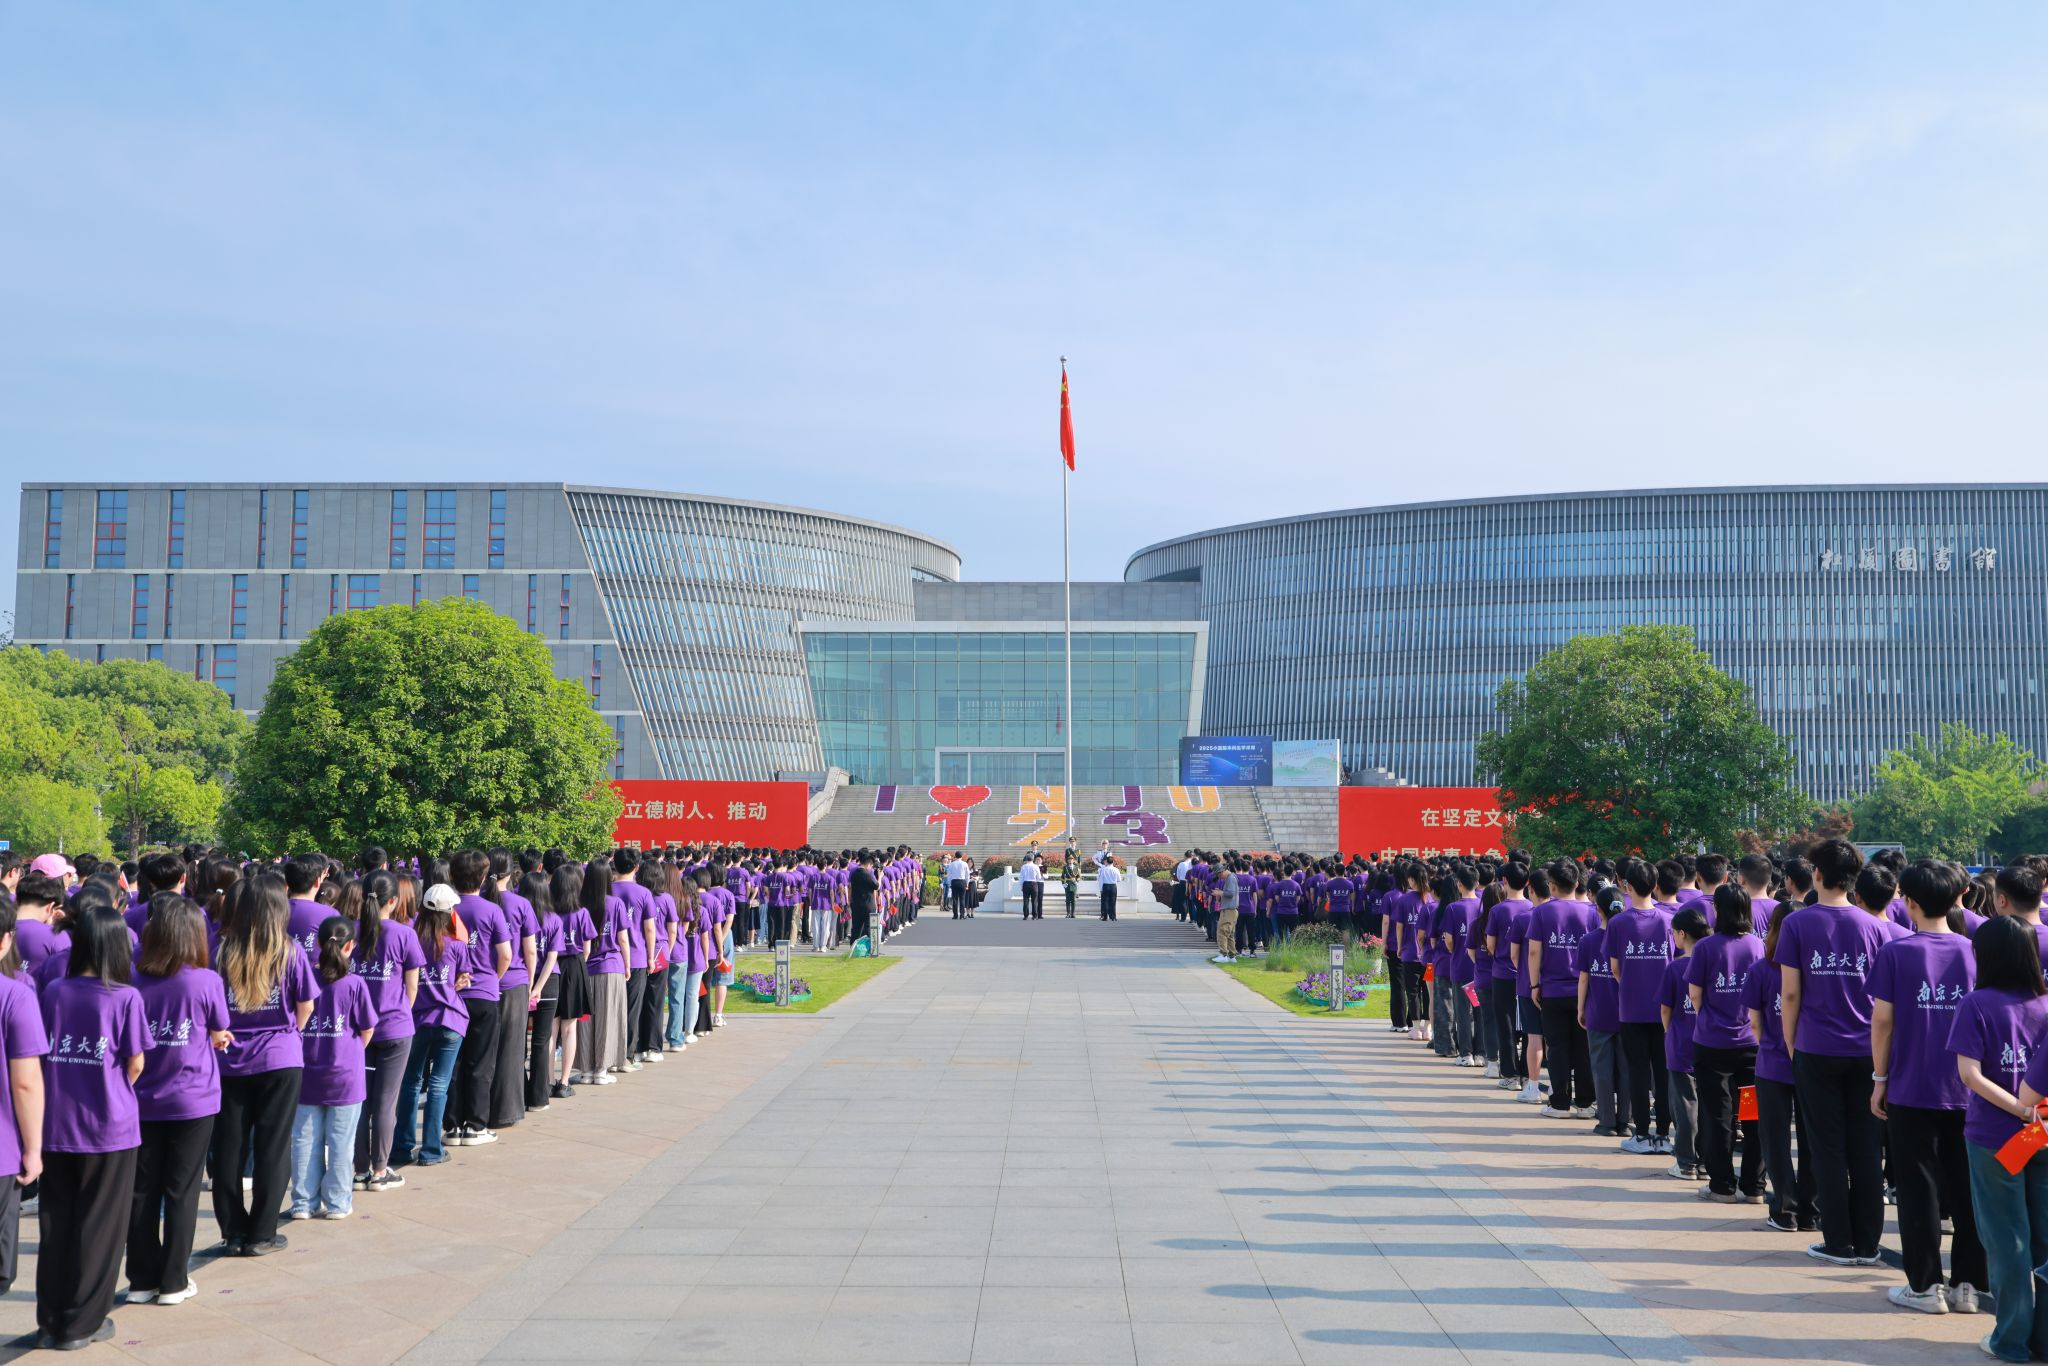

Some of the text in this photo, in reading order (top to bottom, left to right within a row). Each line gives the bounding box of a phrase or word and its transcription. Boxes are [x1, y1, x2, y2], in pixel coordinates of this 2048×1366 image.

[615, 800, 767, 820] 立德树人、推动
[1548, 931, 1579, 944] 南京大
[1810, 949, 1868, 971] 南京大學
[419, 965, 450, 980] 京大學
[1917, 980, 1965, 1002] 南京大
[149, 1018, 193, 1039] 京大學
[309, 1014, 346, 1032] 京大學
[49, 1032, 109, 1060] 京大學
